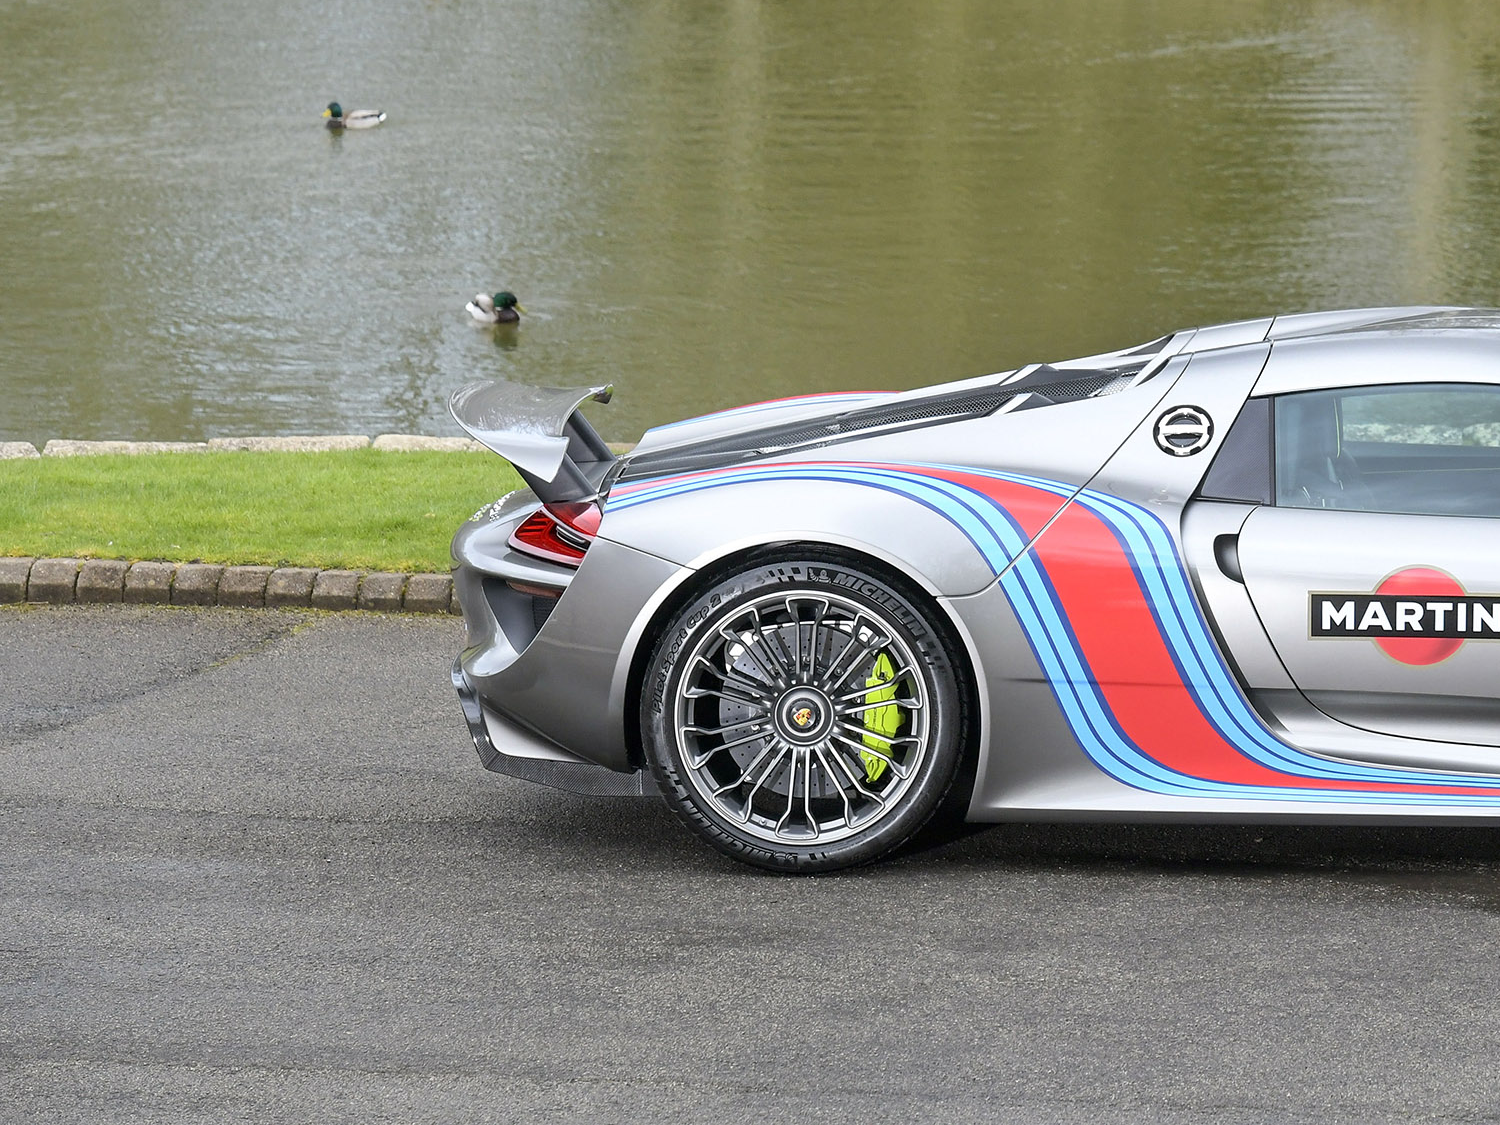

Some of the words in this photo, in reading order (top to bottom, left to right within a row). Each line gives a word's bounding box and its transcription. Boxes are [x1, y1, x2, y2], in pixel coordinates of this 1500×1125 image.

[833, 572, 928, 638] MICHELIN
[651, 671, 667, 715] Pilot
[661, 628, 688, 674] Sport
[686, 605, 710, 630] Cup
[710, 593, 722, 608] 2
